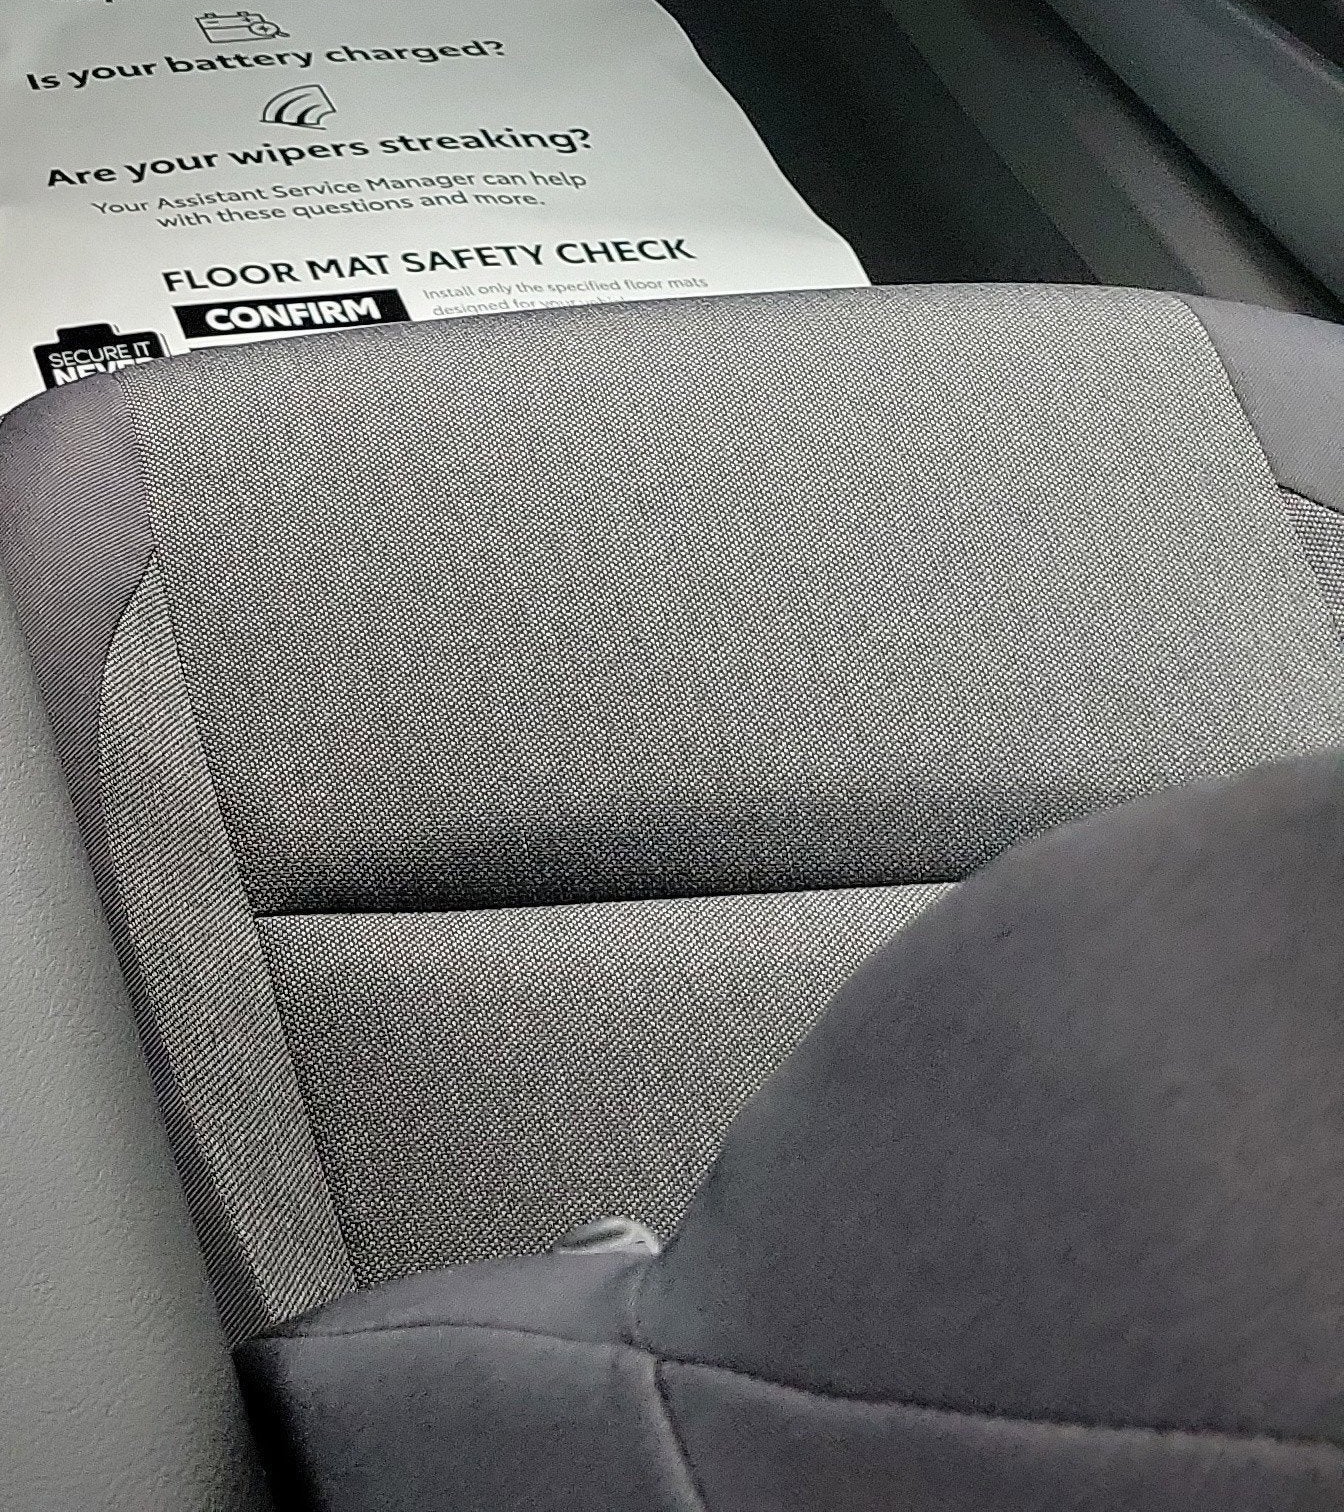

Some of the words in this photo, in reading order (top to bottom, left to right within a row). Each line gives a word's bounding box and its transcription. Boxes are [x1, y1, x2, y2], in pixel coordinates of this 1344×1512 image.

[25, 72, 62, 90] Is
[67, 59, 158, 89] your
[164, 46, 314, 76] battery
[324, 40, 507, 65] charged?
[47, 168, 118, 188] Are
[124, 150, 219, 185] your
[227, 141, 370, 168] wipers
[378, 128, 593, 155] streaking?
[92, 199, 151, 216] Your
[157, 187, 267, 210] Assistant
[272, 179, 362, 200] Service
[365, 172, 475, 196] Manager
[482, 171, 526, 186] can
[532, 170, 588, 190] help
[156, 213, 212, 229] with
[216, 205, 286, 224] these
[292, 195, 414, 220] questions
[418, 190, 469, 208] and
[475, 190, 546, 206] more.
[162, 262, 302, 292] FLOOR
[305, 254, 390, 280] MAT
[401, 244, 544, 273] SAFETY
[555, 238, 698, 264] CHECK
[422, 285, 475, 300] Install
[478, 281, 513, 296] only
[515, 280, 544, 293] the
[547, 276, 621, 295] specified
[623, 277, 663, 290] floor
[667, 275, 709, 289] mats
[204, 296, 383, 332] CONFIRM
[432, 299, 508, 317] designed
[512, 298, 536, 309] for
[47, 344, 131, 369] SECURE
[132, 340, 151, 357] IT
